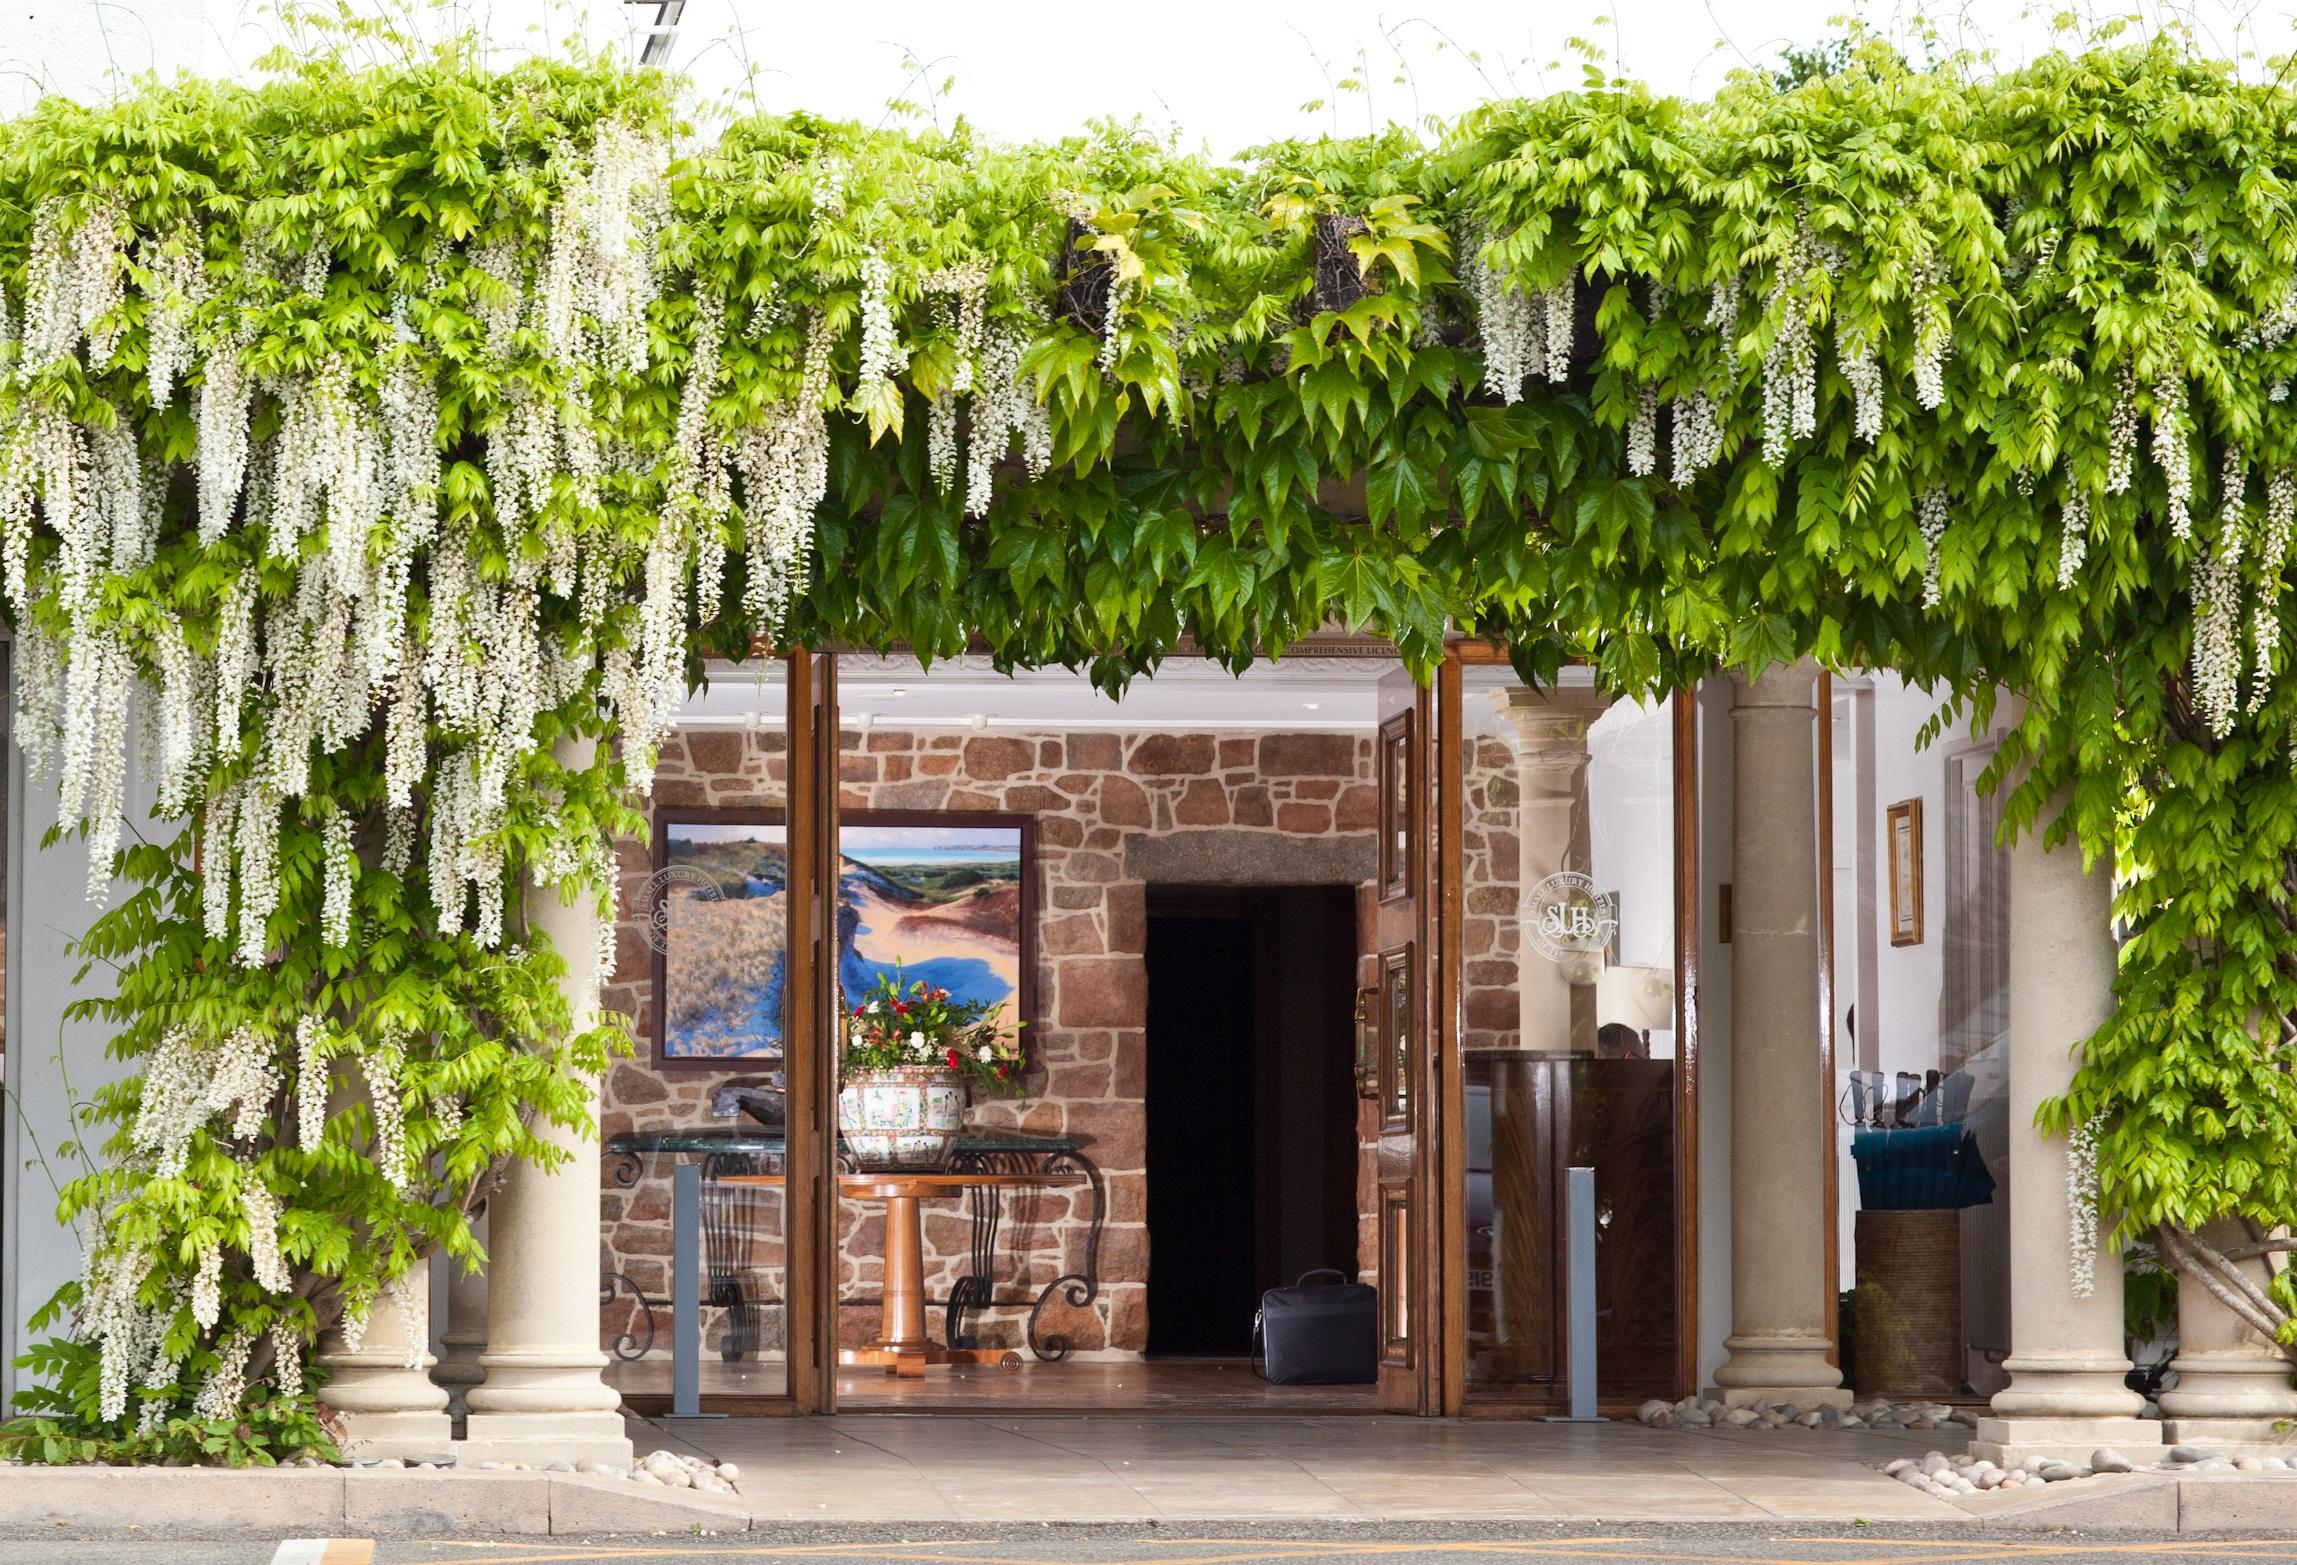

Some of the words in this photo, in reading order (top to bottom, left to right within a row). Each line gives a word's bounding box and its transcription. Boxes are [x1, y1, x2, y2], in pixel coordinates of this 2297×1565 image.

[1367, 645, 1401, 655] LICENC
[658, 871, 697, 883] LUXURY
[1546, 875, 1585, 890] LUXURY
[1542, 902, 1595, 937] SLH
